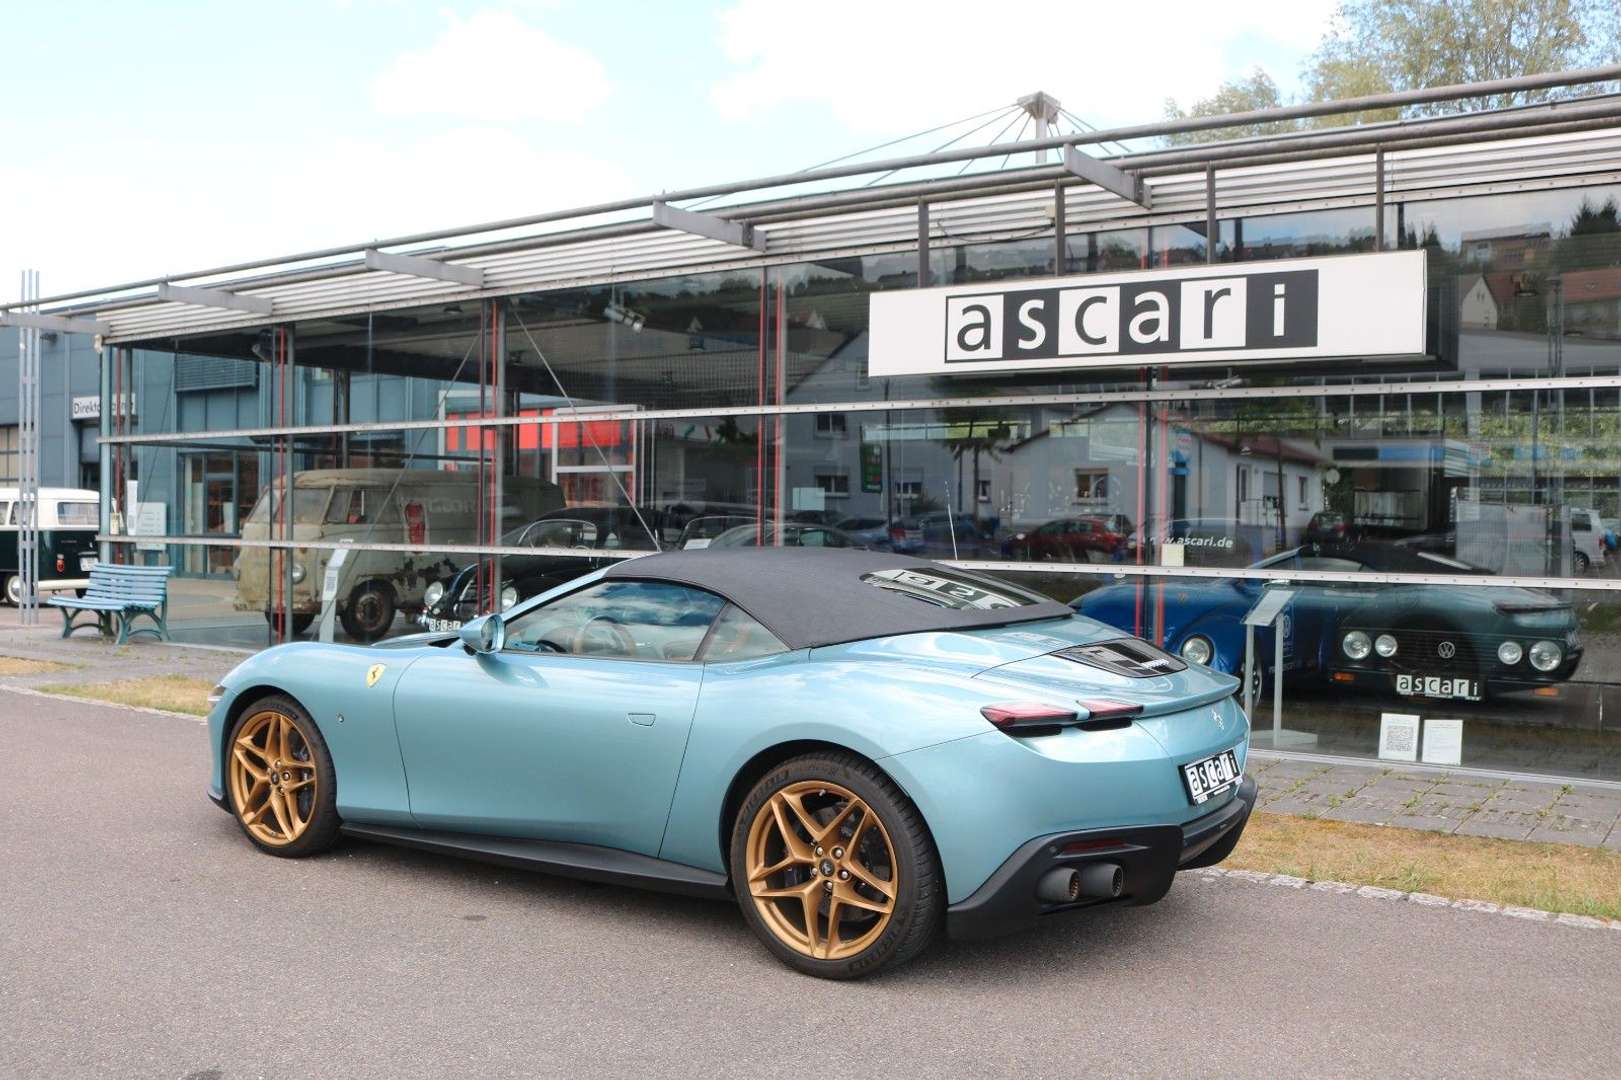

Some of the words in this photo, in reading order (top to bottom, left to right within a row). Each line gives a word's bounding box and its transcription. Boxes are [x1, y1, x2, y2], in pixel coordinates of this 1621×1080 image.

[956, 283, 1286, 352] ascari
[1399, 676, 1478, 696] ascari
[1188, 753, 1238, 792] ascari
